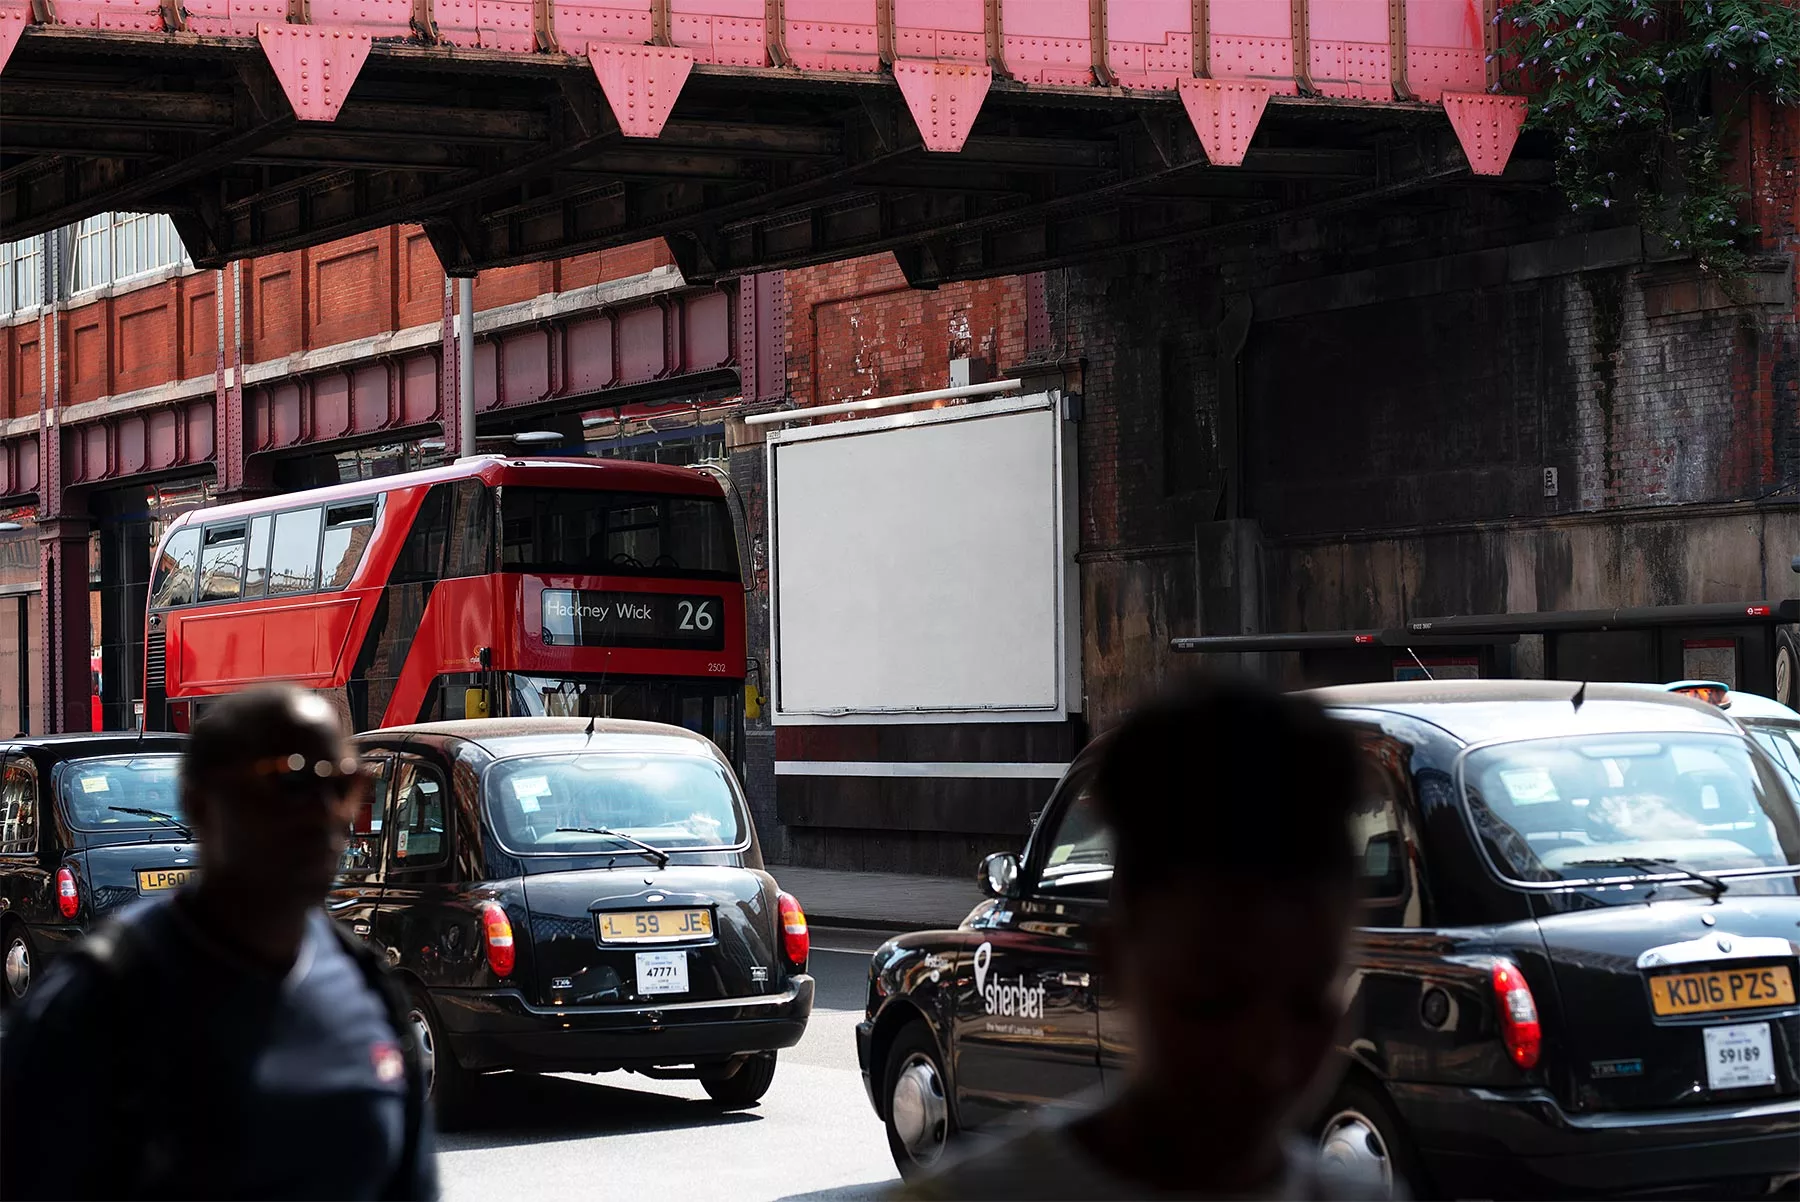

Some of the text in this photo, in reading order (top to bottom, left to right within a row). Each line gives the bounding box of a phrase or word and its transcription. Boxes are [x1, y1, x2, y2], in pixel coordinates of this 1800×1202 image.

[547, 600, 652, 622] Hackney Wick
[677, 600, 714, 631] 26
[708, 662, 726, 672] 2502
[147, 872, 185, 887] LP60
[608, 913, 703, 935] L 59 JE
[646, 966, 677, 977] 47771
[984, 972, 1046, 1019] sherbet
[1666, 971, 1779, 1007] KD16 PZS
[1719, 1045, 1760, 1064] 59189
